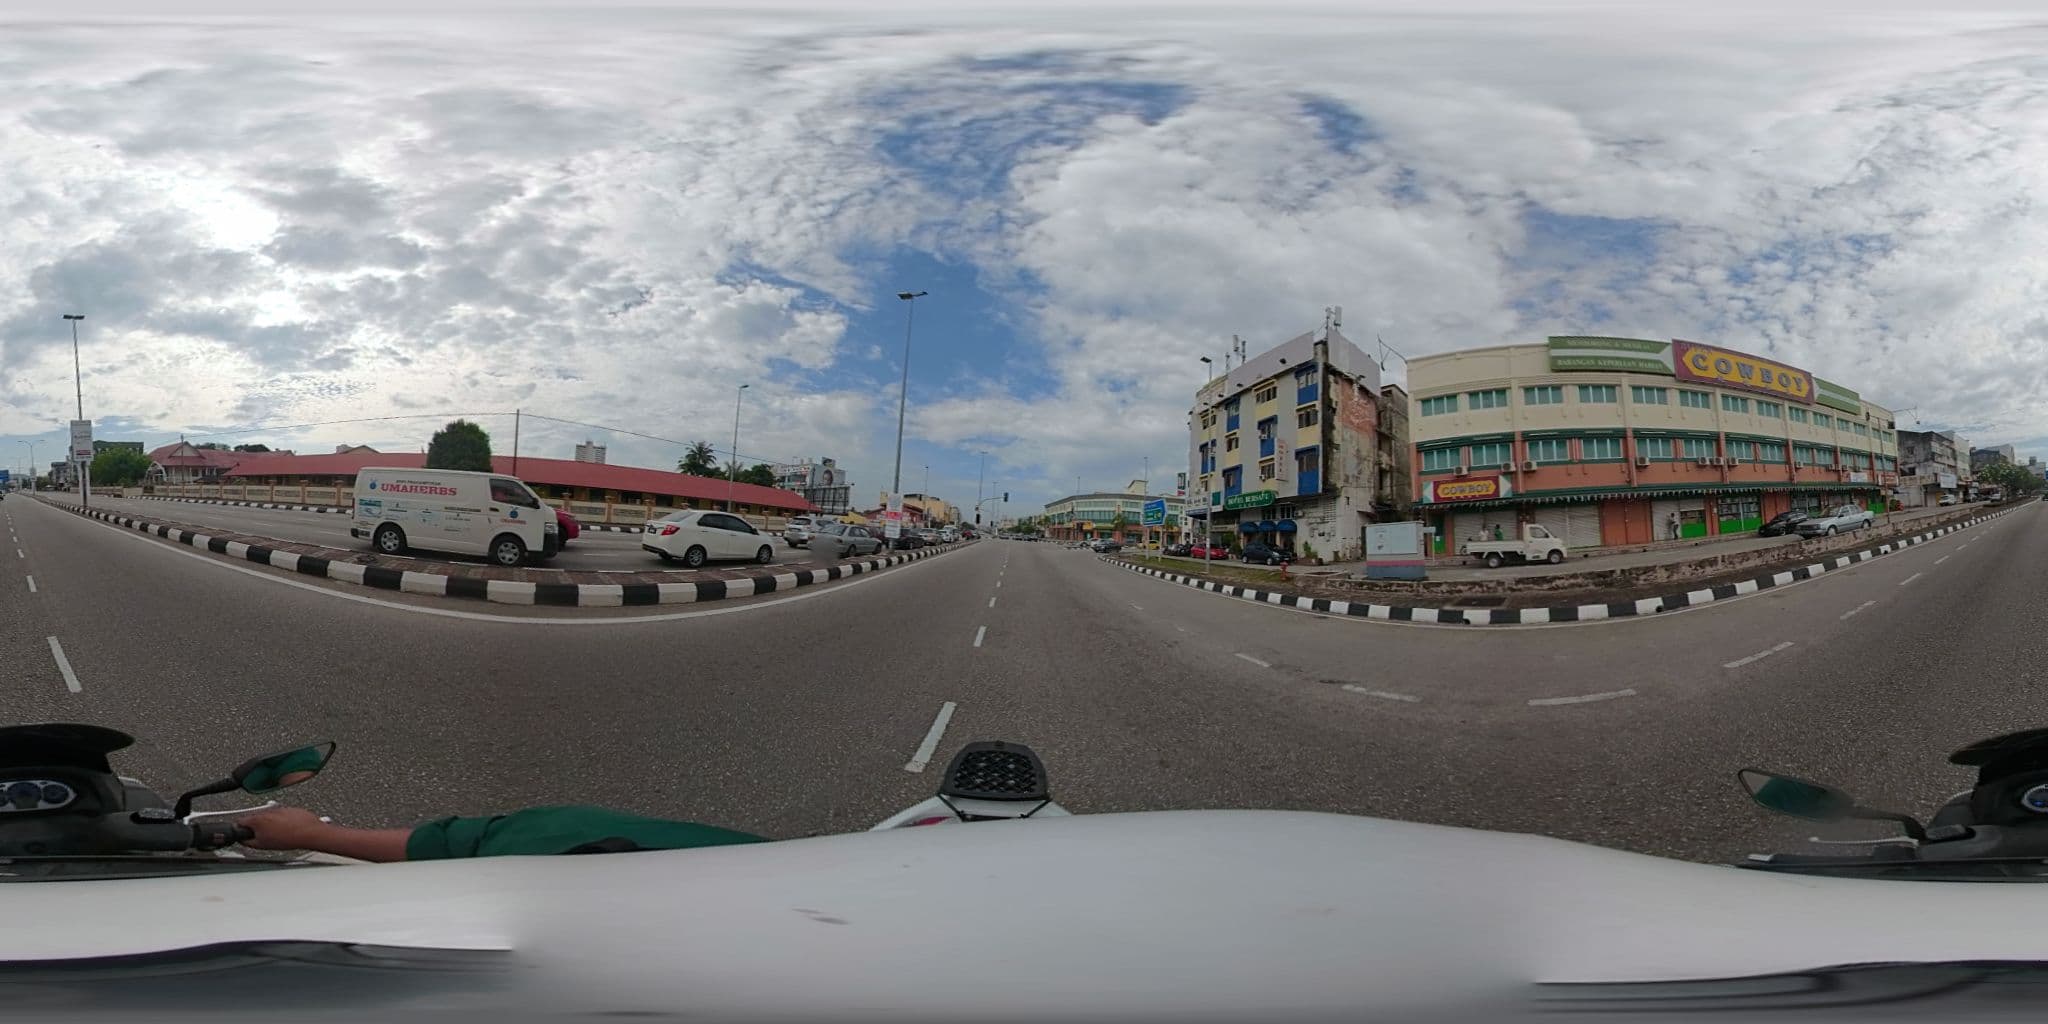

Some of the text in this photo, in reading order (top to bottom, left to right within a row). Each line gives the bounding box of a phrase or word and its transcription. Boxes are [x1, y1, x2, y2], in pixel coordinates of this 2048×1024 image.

[1557, 359, 1595, 367] BARANGAN
[1691, 353, 1803, 392] COWBOY
[381, 483, 457, 496] UMAHERBS
[1441, 483, 1491, 496] COWBOY
